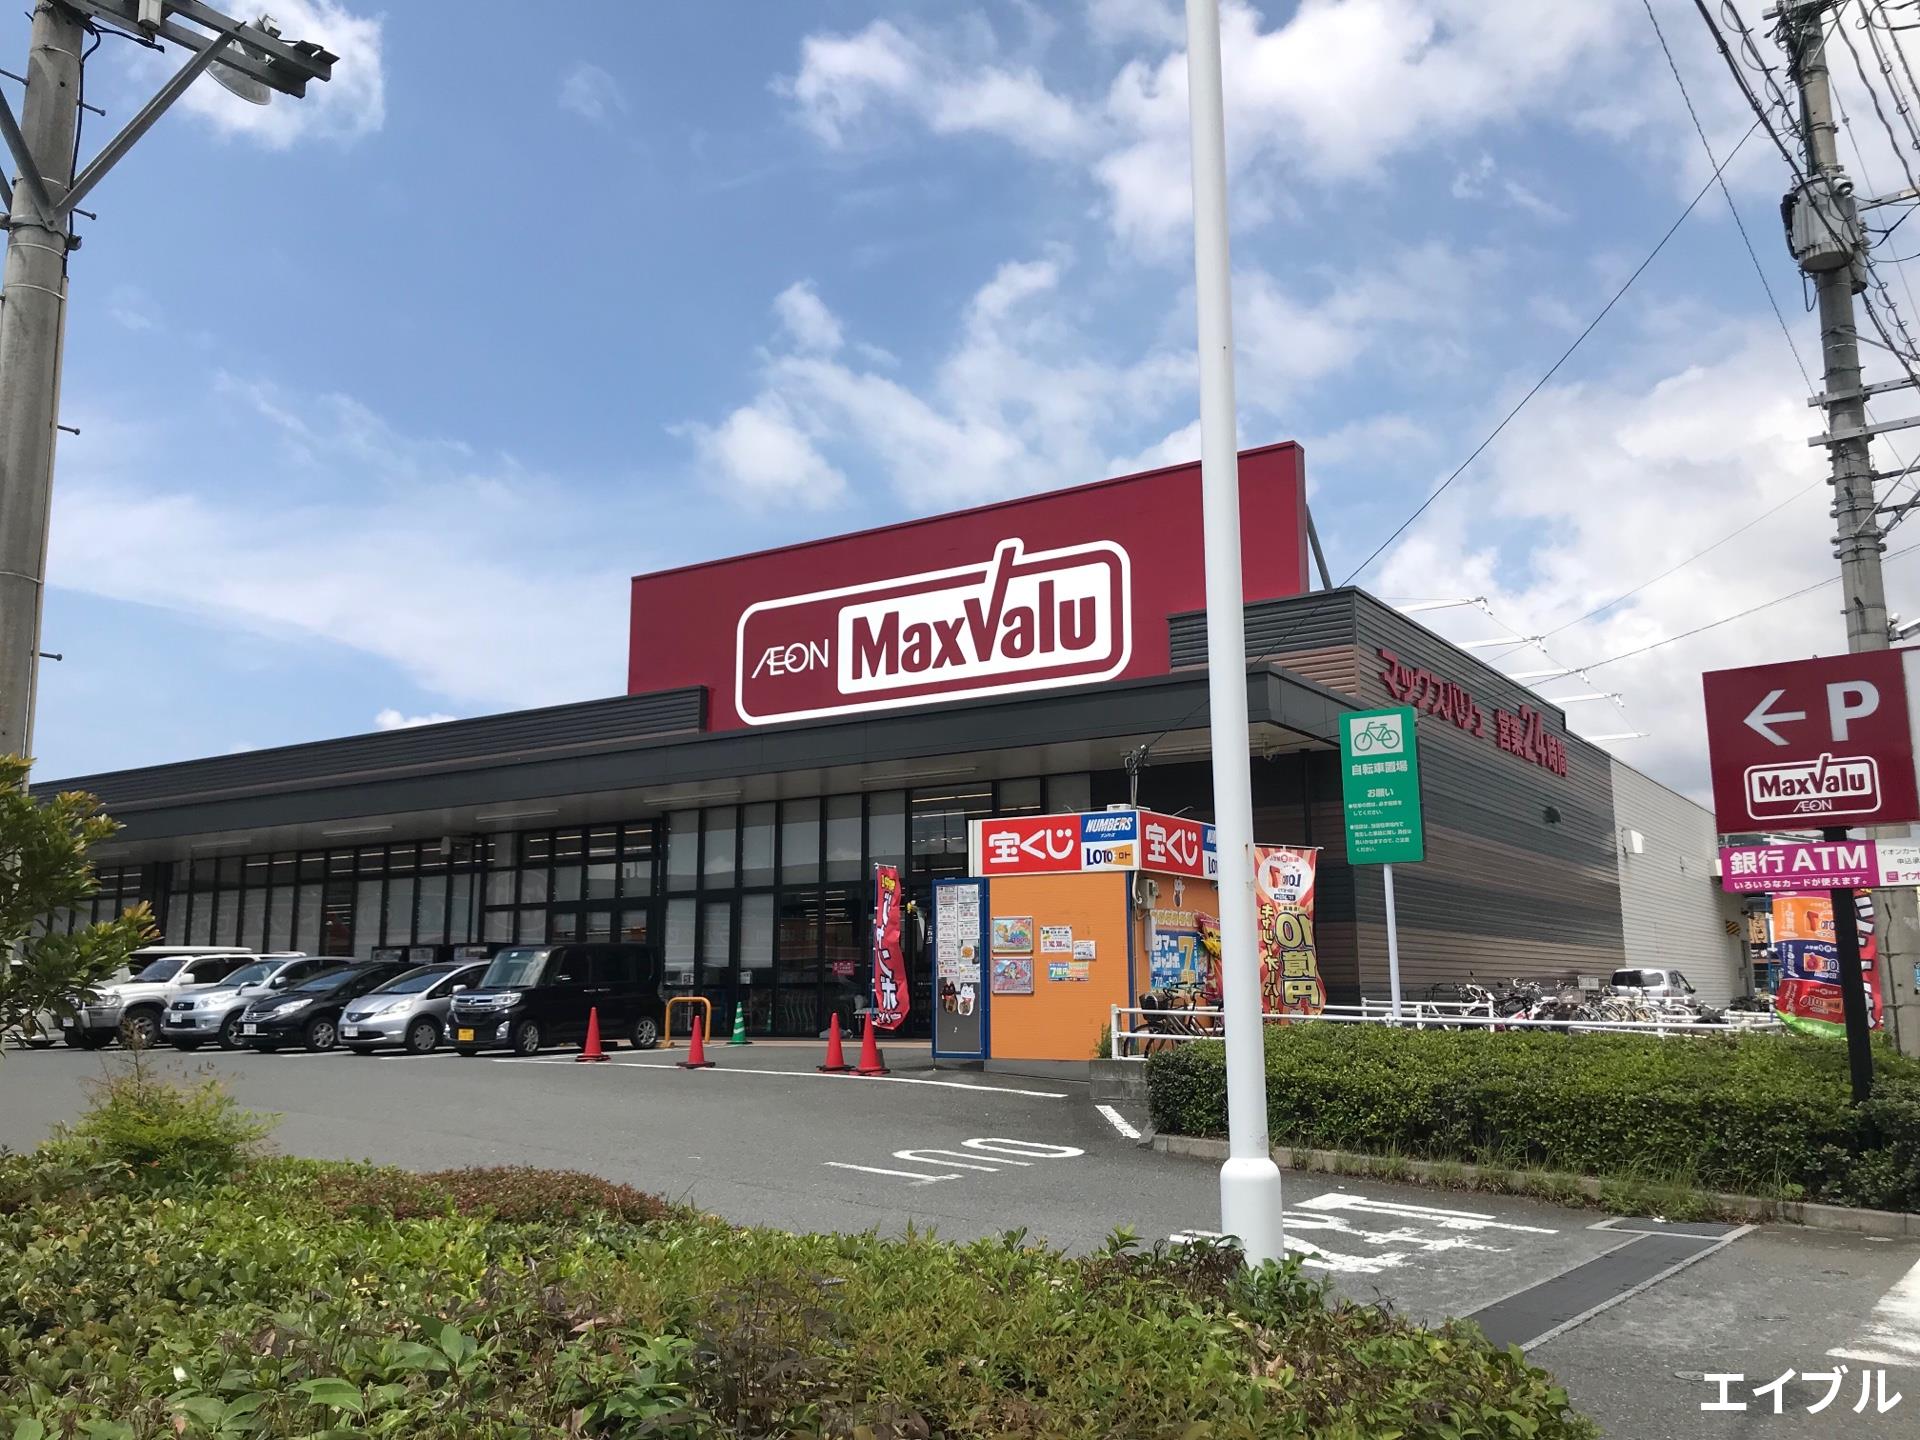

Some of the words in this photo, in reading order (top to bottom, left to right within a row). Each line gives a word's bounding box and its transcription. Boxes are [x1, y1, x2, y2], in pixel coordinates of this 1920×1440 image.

[851, 546, 1097, 680] MaxValu
[1377, 648, 1485, 738] マックスバリュ
[1494, 703, 1568, 778] 営業24時間
[1826, 679, 1880, 743] P
[1351, 761, 1408, 776] 自転車置場
[1758, 755, 1866, 799] MaxValu
[1367, 787, 1394, 798] お願い
[1085, 816, 1133, 833] NUMBERS
[988, 828, 1074, 864] 宝くじ
[1086, 847, 1113, 866] LOTO
[1146, 822, 1198, 867] 宝くじ
[1730, 849, 1785, 875] 銀行
[1792, 845, 1868, 872] ATM
